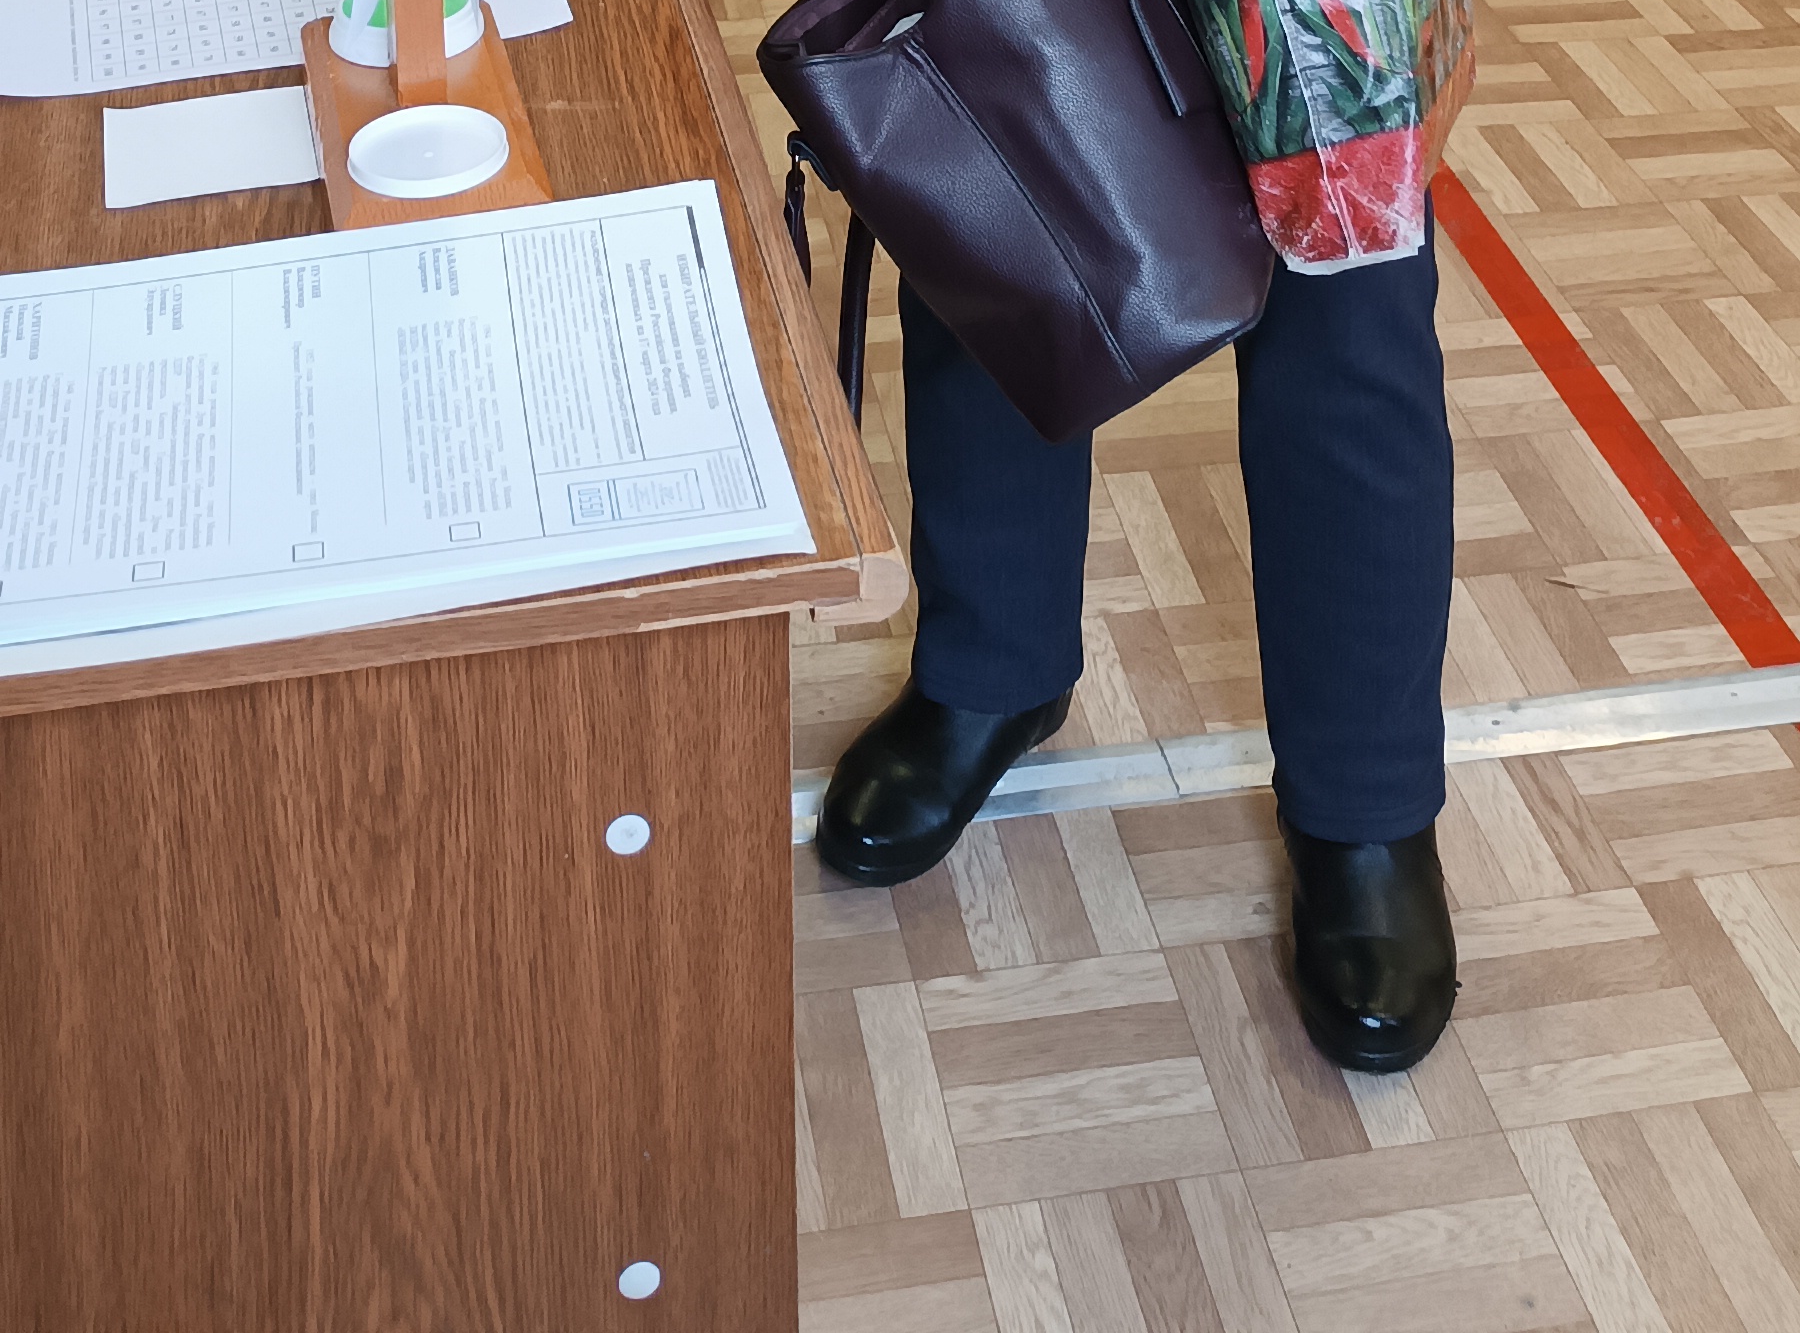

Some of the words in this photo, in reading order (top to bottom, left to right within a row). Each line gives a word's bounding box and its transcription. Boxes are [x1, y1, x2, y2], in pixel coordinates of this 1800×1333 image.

[311, 265, 321, 298] ПУТИН
[445, 245, 459, 296] ДАВАНКОВ
[639, 259, 656, 311] Президента
[650, 313, 668, 365] Российской
[676, 254, 706, 345] ИЗБИРАТЕЛЬНЫЙ
[696, 348, 719, 410] БЮЛЛЕТЕНЬ
